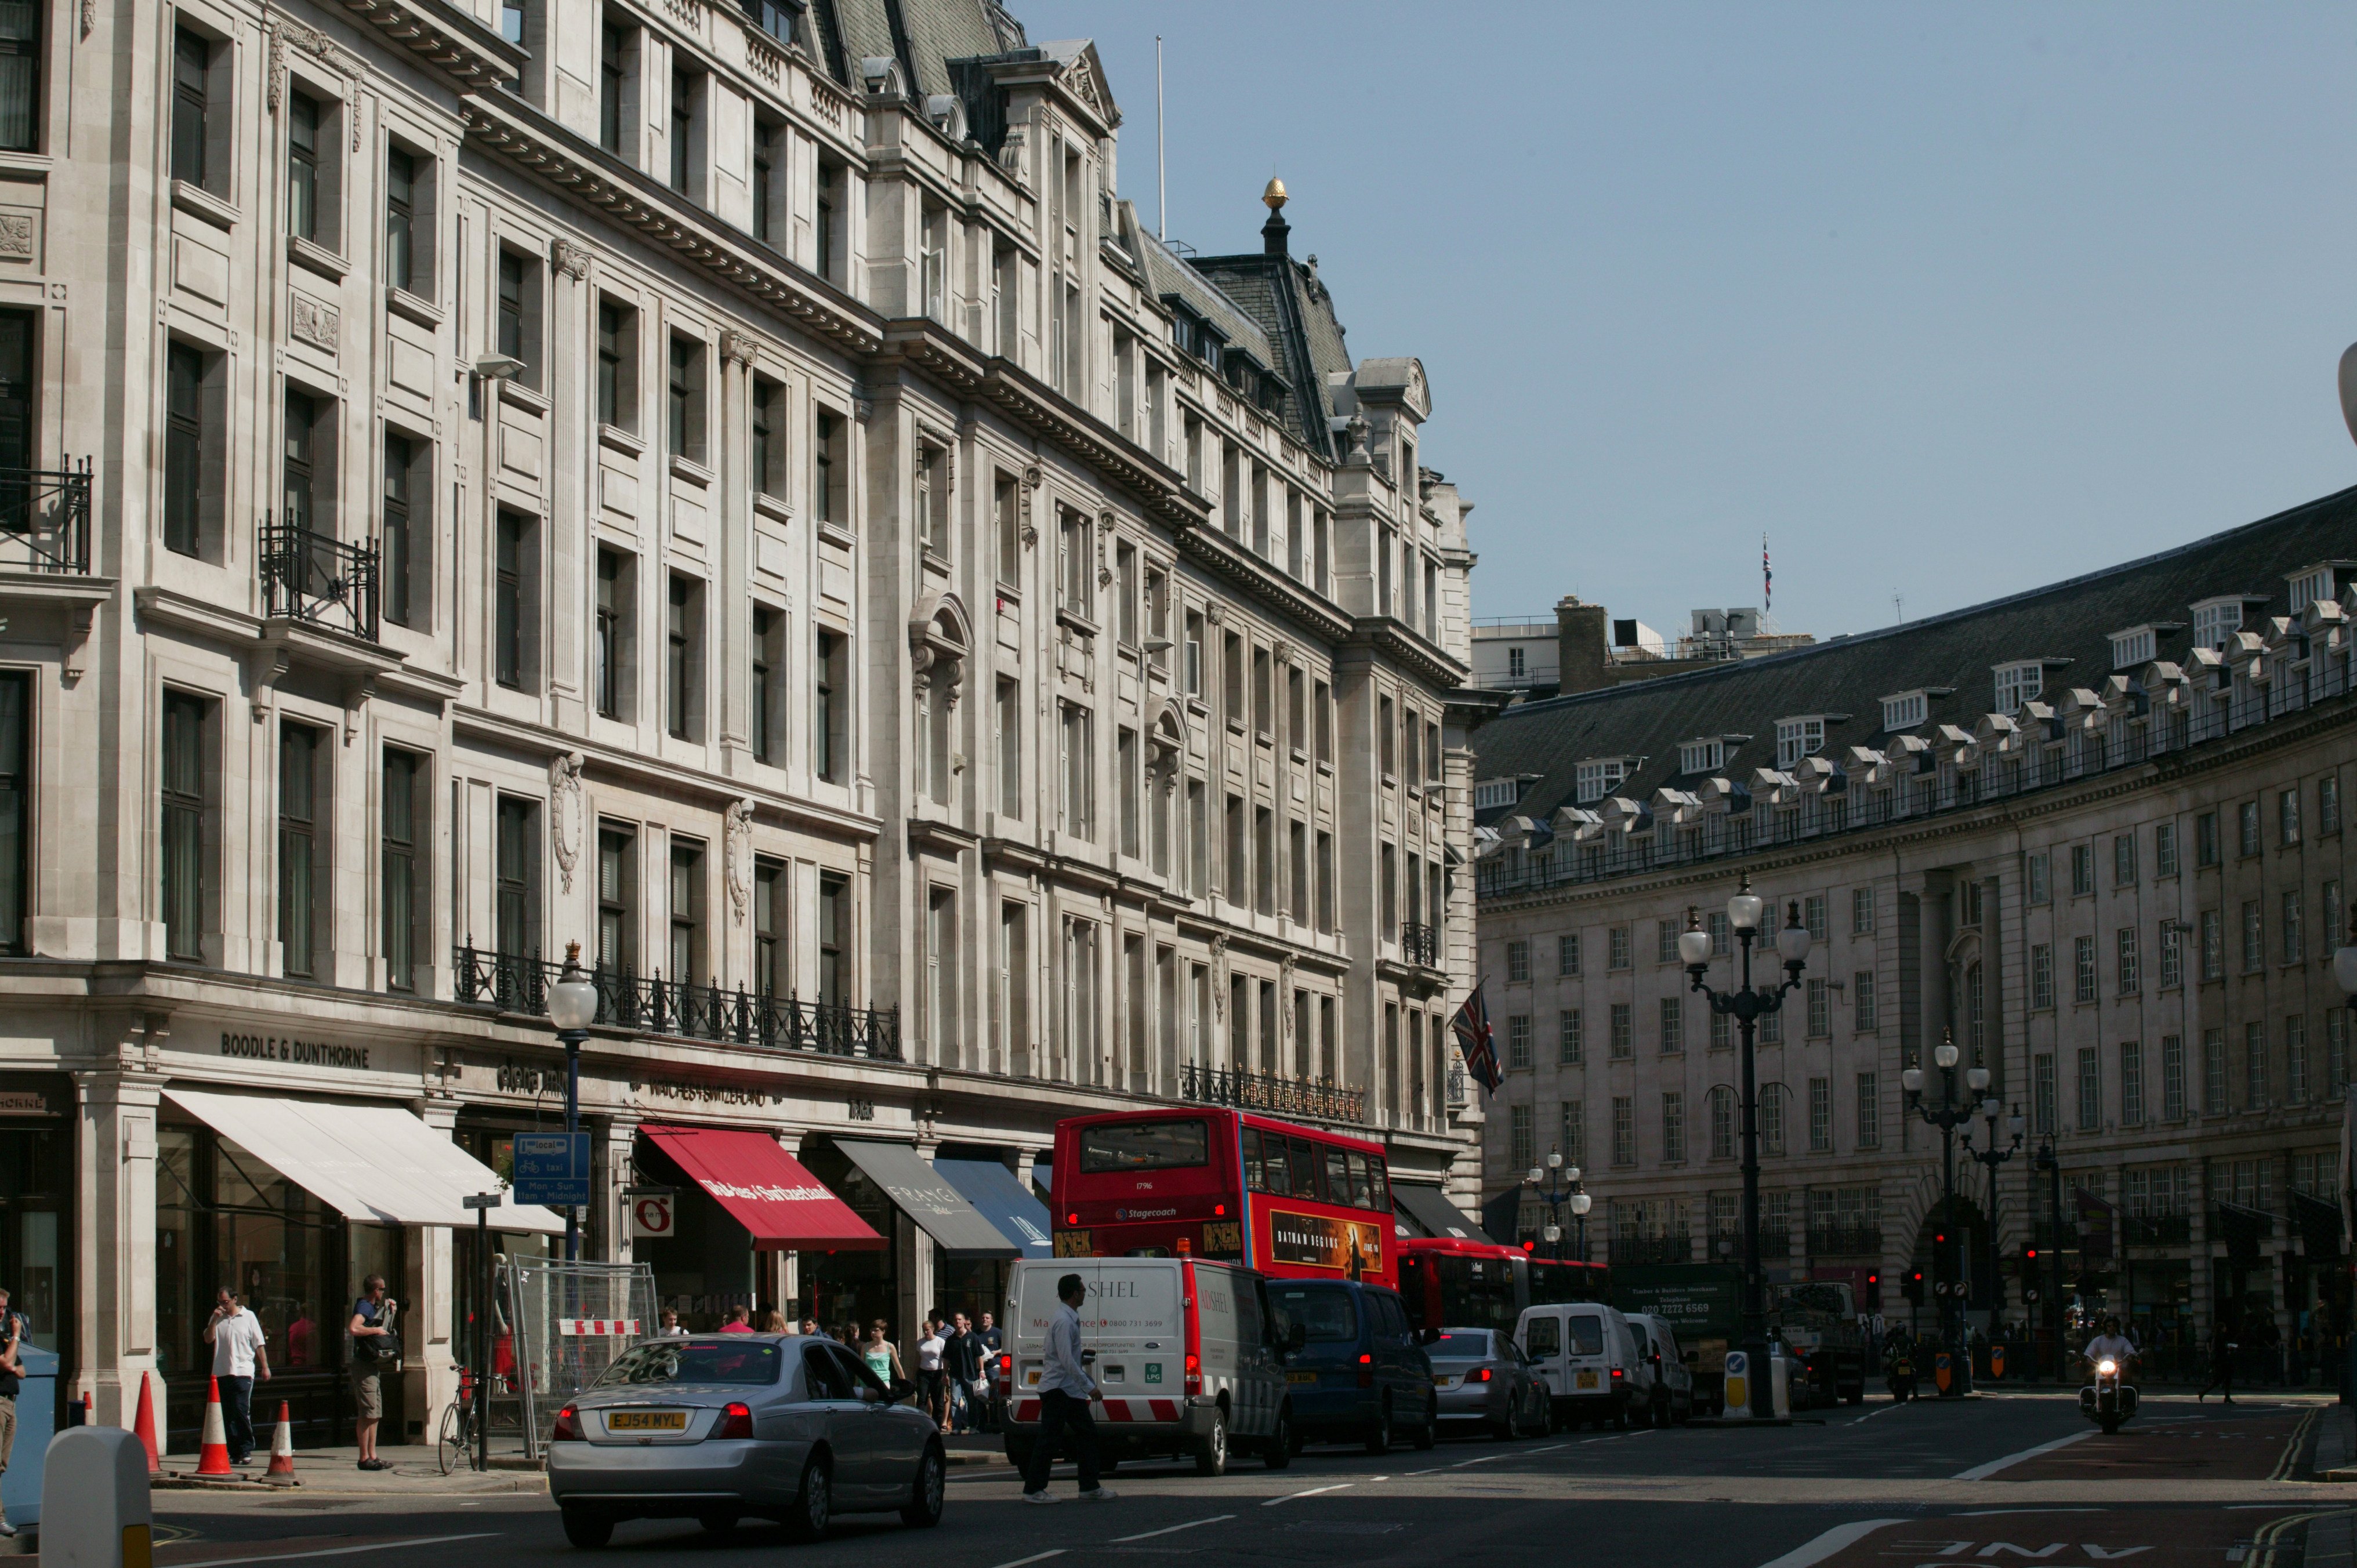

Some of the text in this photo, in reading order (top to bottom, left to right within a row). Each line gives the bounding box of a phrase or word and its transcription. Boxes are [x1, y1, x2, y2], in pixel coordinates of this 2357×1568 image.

[221, 1032, 369, 1069] BOODLE & DUNTHORNE
[535, 1140, 556, 1149] local
[546, 1163, 563, 1171] taxi
[1137, 1182, 1152, 1190] 17916
[517, 1192, 538, 1200] 11am
[547, 1191, 586, 1201] Midnight
[1129, 1207, 1176, 1219] Stagecoach
[1203, 1222, 1241, 1251] ROCK
[1278, 1231, 1337, 1249] BATMAN BEGINS
[1054, 1231, 1091, 1257] ROCK
[1201, 1289, 1228, 1313] ADSHEL
[1641, 1303, 1709, 1314] 020 7272 6569
[614, 1414, 679, 1427] EJ54 MYL
